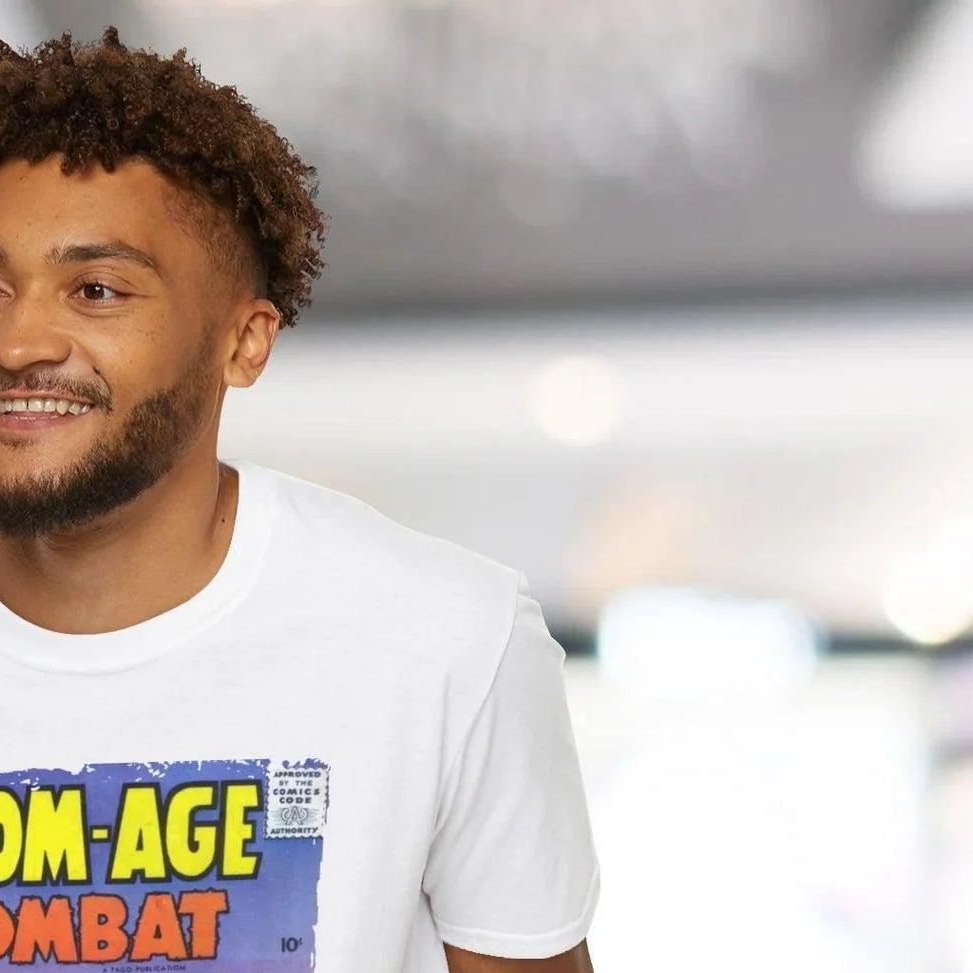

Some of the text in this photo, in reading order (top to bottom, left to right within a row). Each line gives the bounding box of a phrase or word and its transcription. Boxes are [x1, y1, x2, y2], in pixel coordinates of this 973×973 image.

[273, 788, 320, 796] COMICS
[279, 796, 312, 804] CODE
[270, 827, 318, 835] AUTHORITY
[136, 964, 186, 973] PUBLICATION
